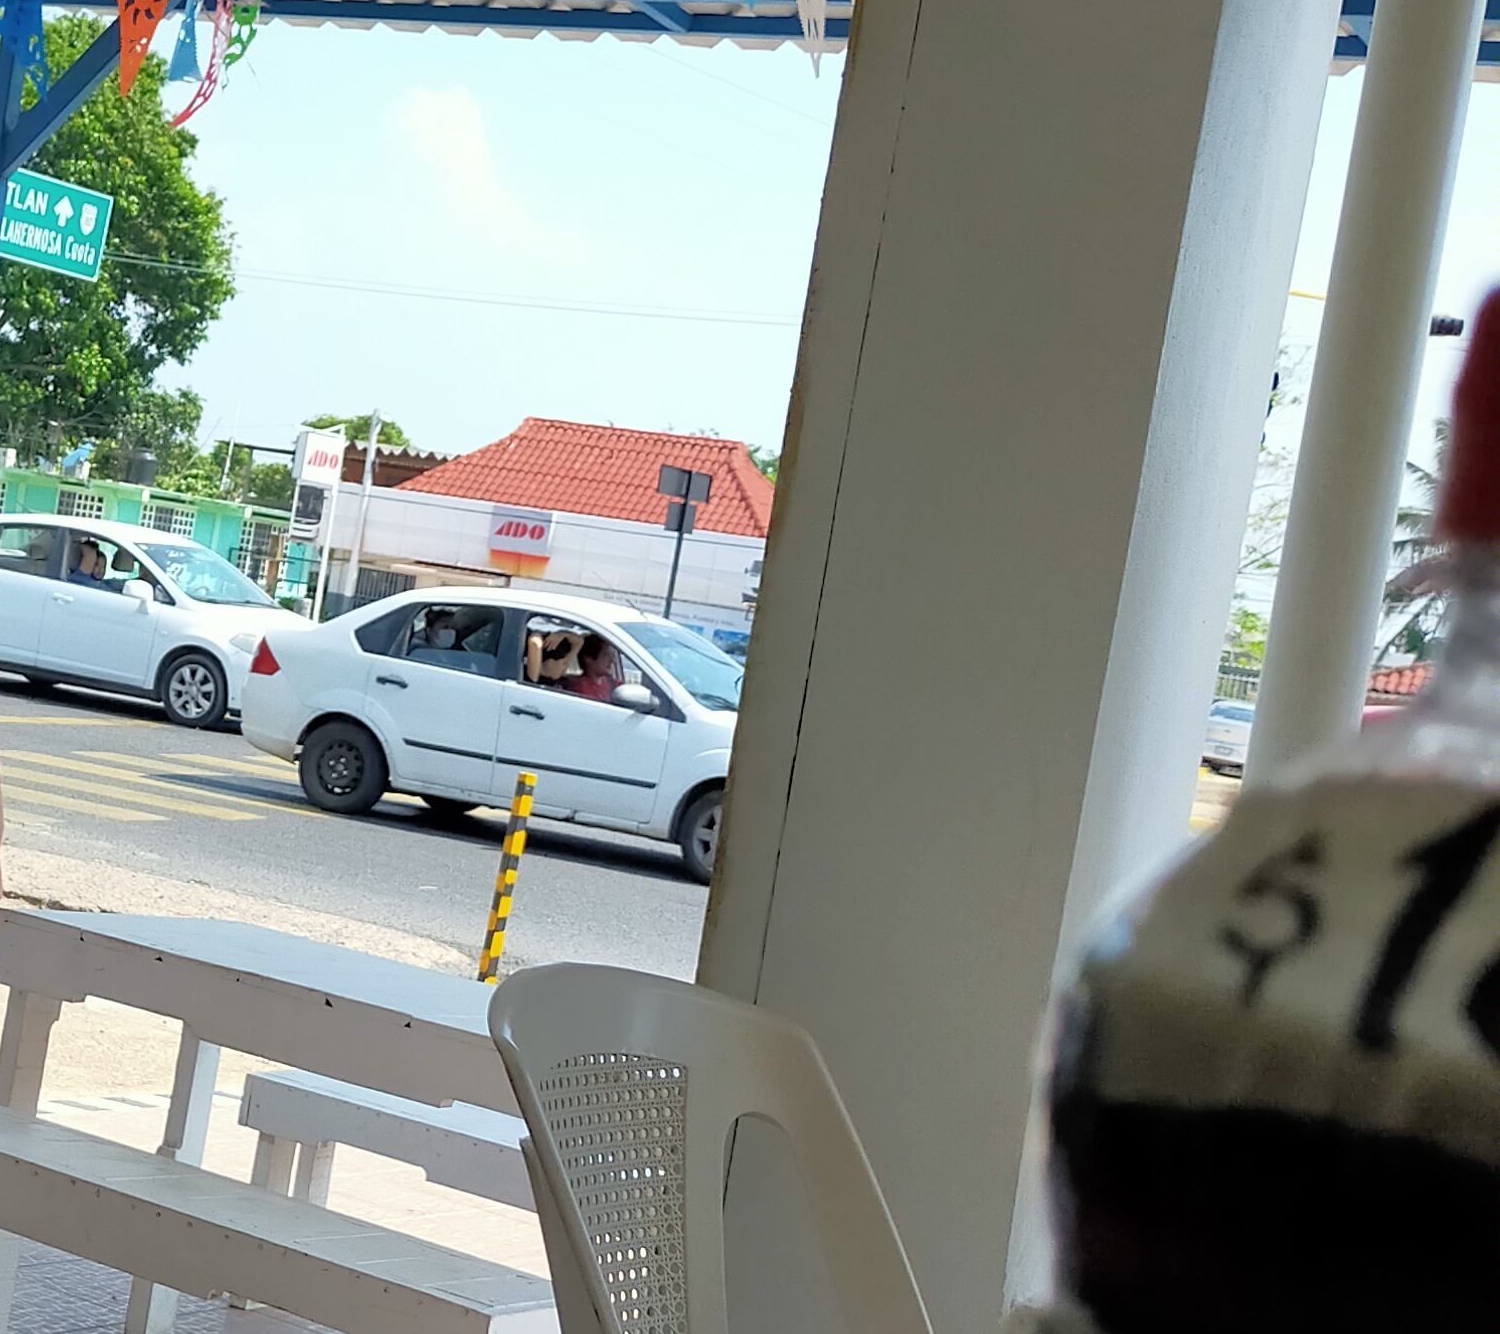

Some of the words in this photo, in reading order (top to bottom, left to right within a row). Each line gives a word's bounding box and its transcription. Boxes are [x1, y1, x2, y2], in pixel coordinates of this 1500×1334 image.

[0, 216, 62, 256] LAHERMOSA
[64, 235, 96, 266] Cuota
[307, 449, 339, 469] ADO
[493, 520, 545, 540] ADO
